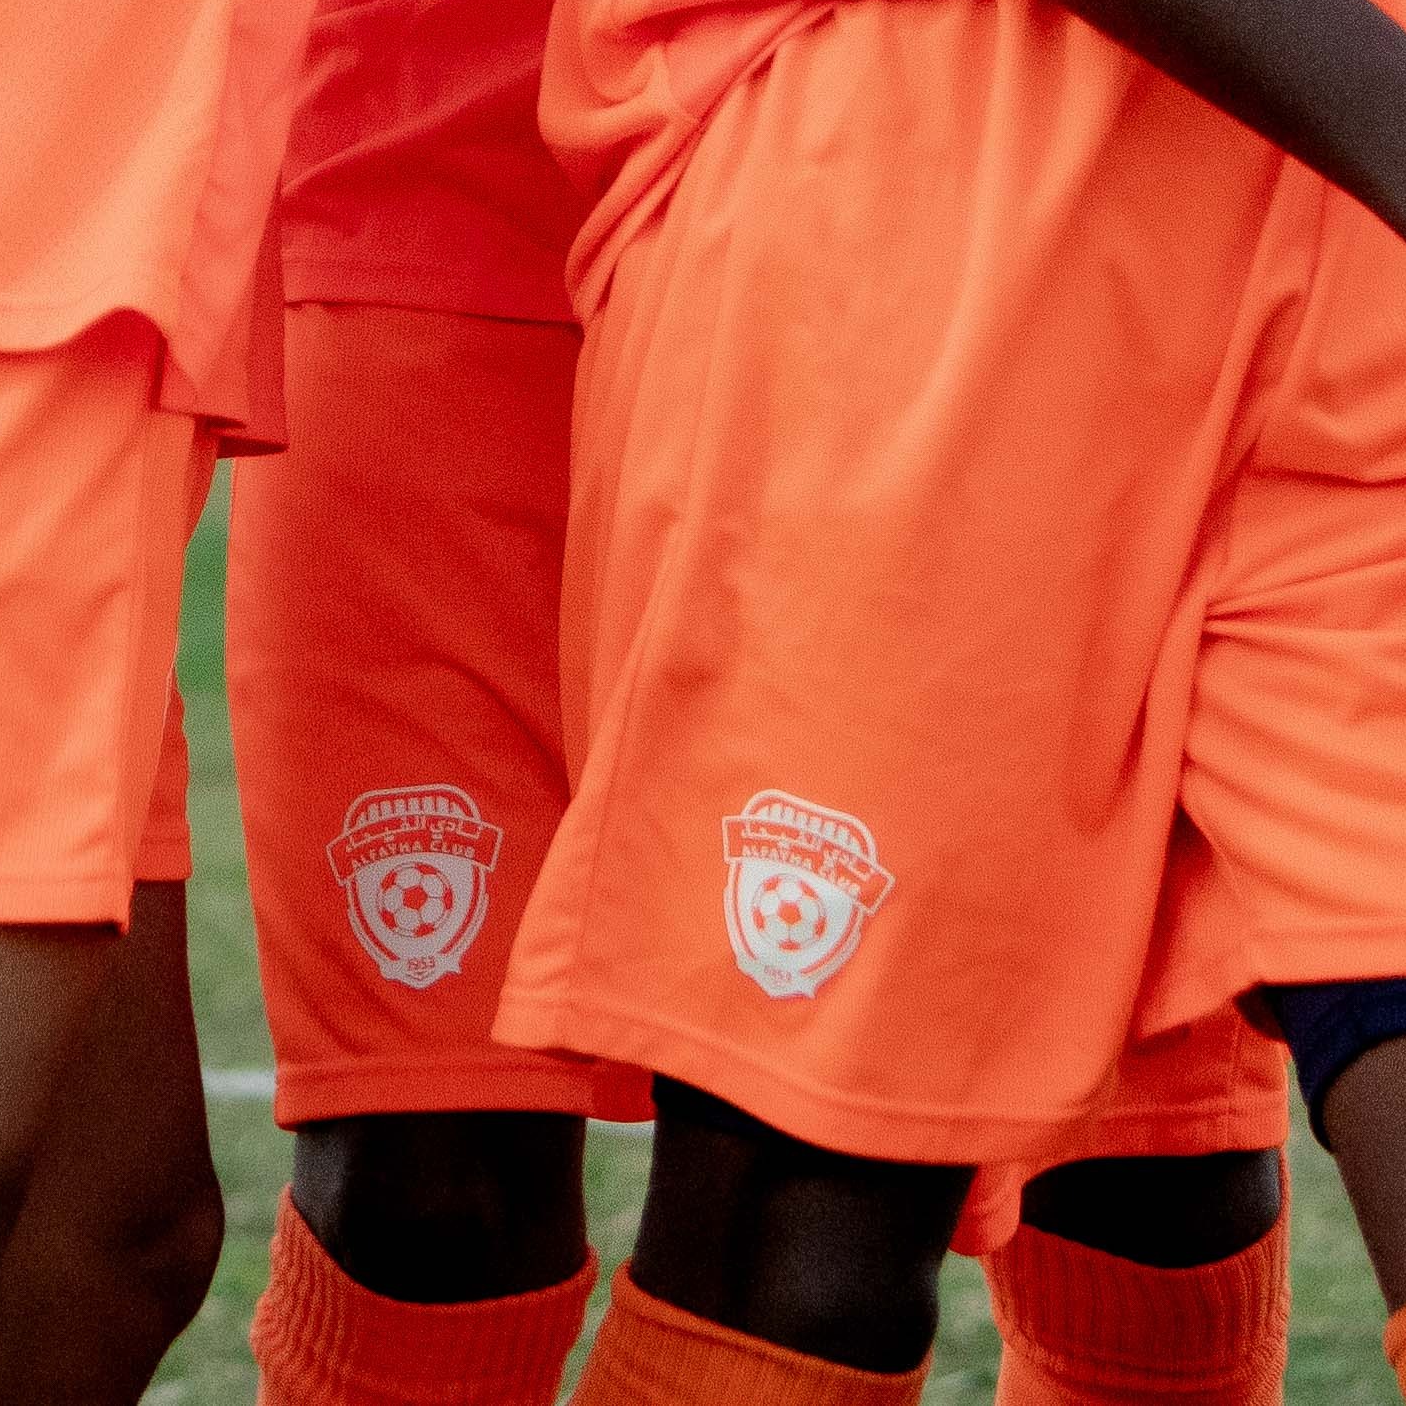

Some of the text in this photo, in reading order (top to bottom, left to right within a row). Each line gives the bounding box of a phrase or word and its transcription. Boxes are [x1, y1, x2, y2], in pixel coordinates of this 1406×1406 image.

[430, 819, 484, 841] نادي
[351, 840, 476, 870] ALFAYHA CLUB
[407, 955, 435, 971] 1953
